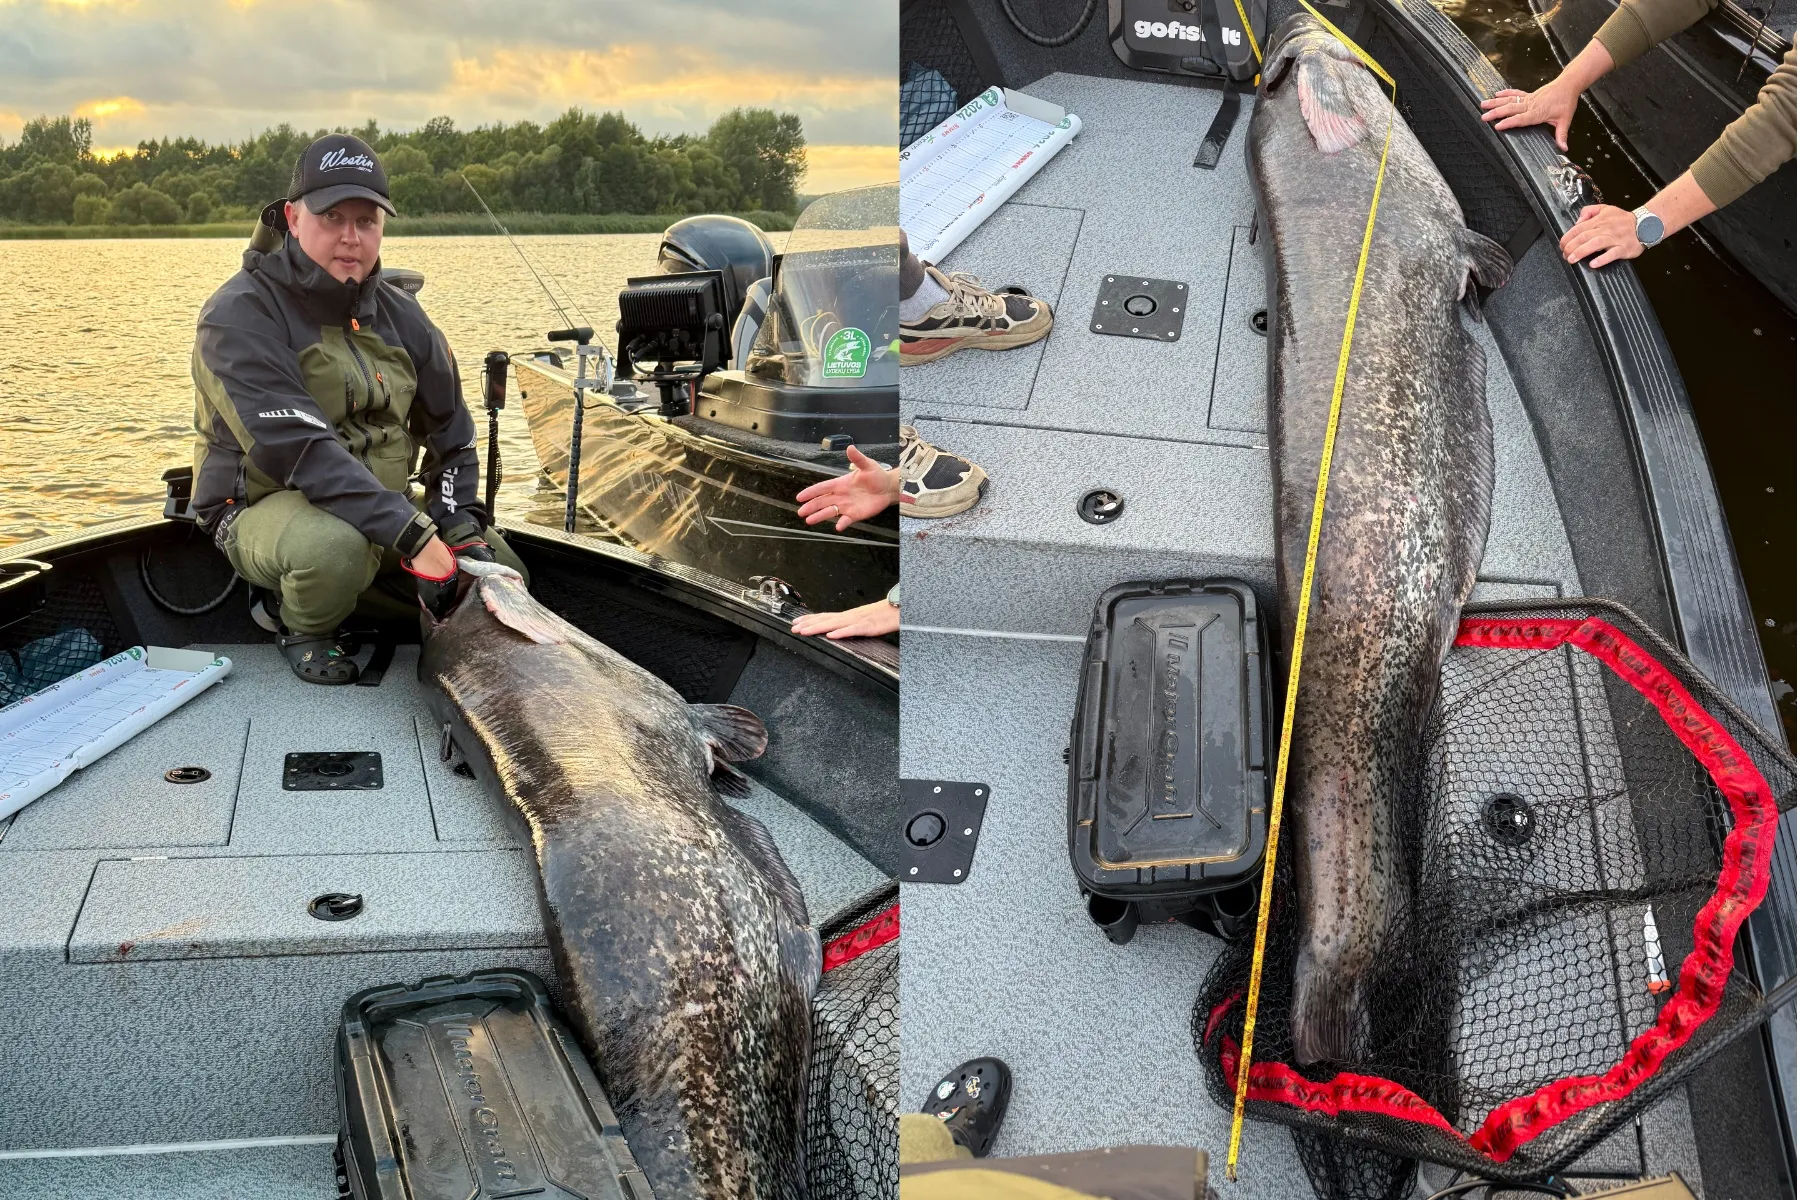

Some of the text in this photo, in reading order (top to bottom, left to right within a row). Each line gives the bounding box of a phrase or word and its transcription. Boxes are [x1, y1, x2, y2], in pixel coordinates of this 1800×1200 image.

[1133, 20, 1241, 45] gofislt
[956, 100, 982, 121] 2024
[319, 147, 374, 171] Westin
[640, 280, 694, 290] GARMIN
[843, 330, 857, 340] 3L
[827, 361, 862, 369] LIETUVOS
[1163, 652, 1182, 729] Major
[450, 1038, 486, 1104] Major
